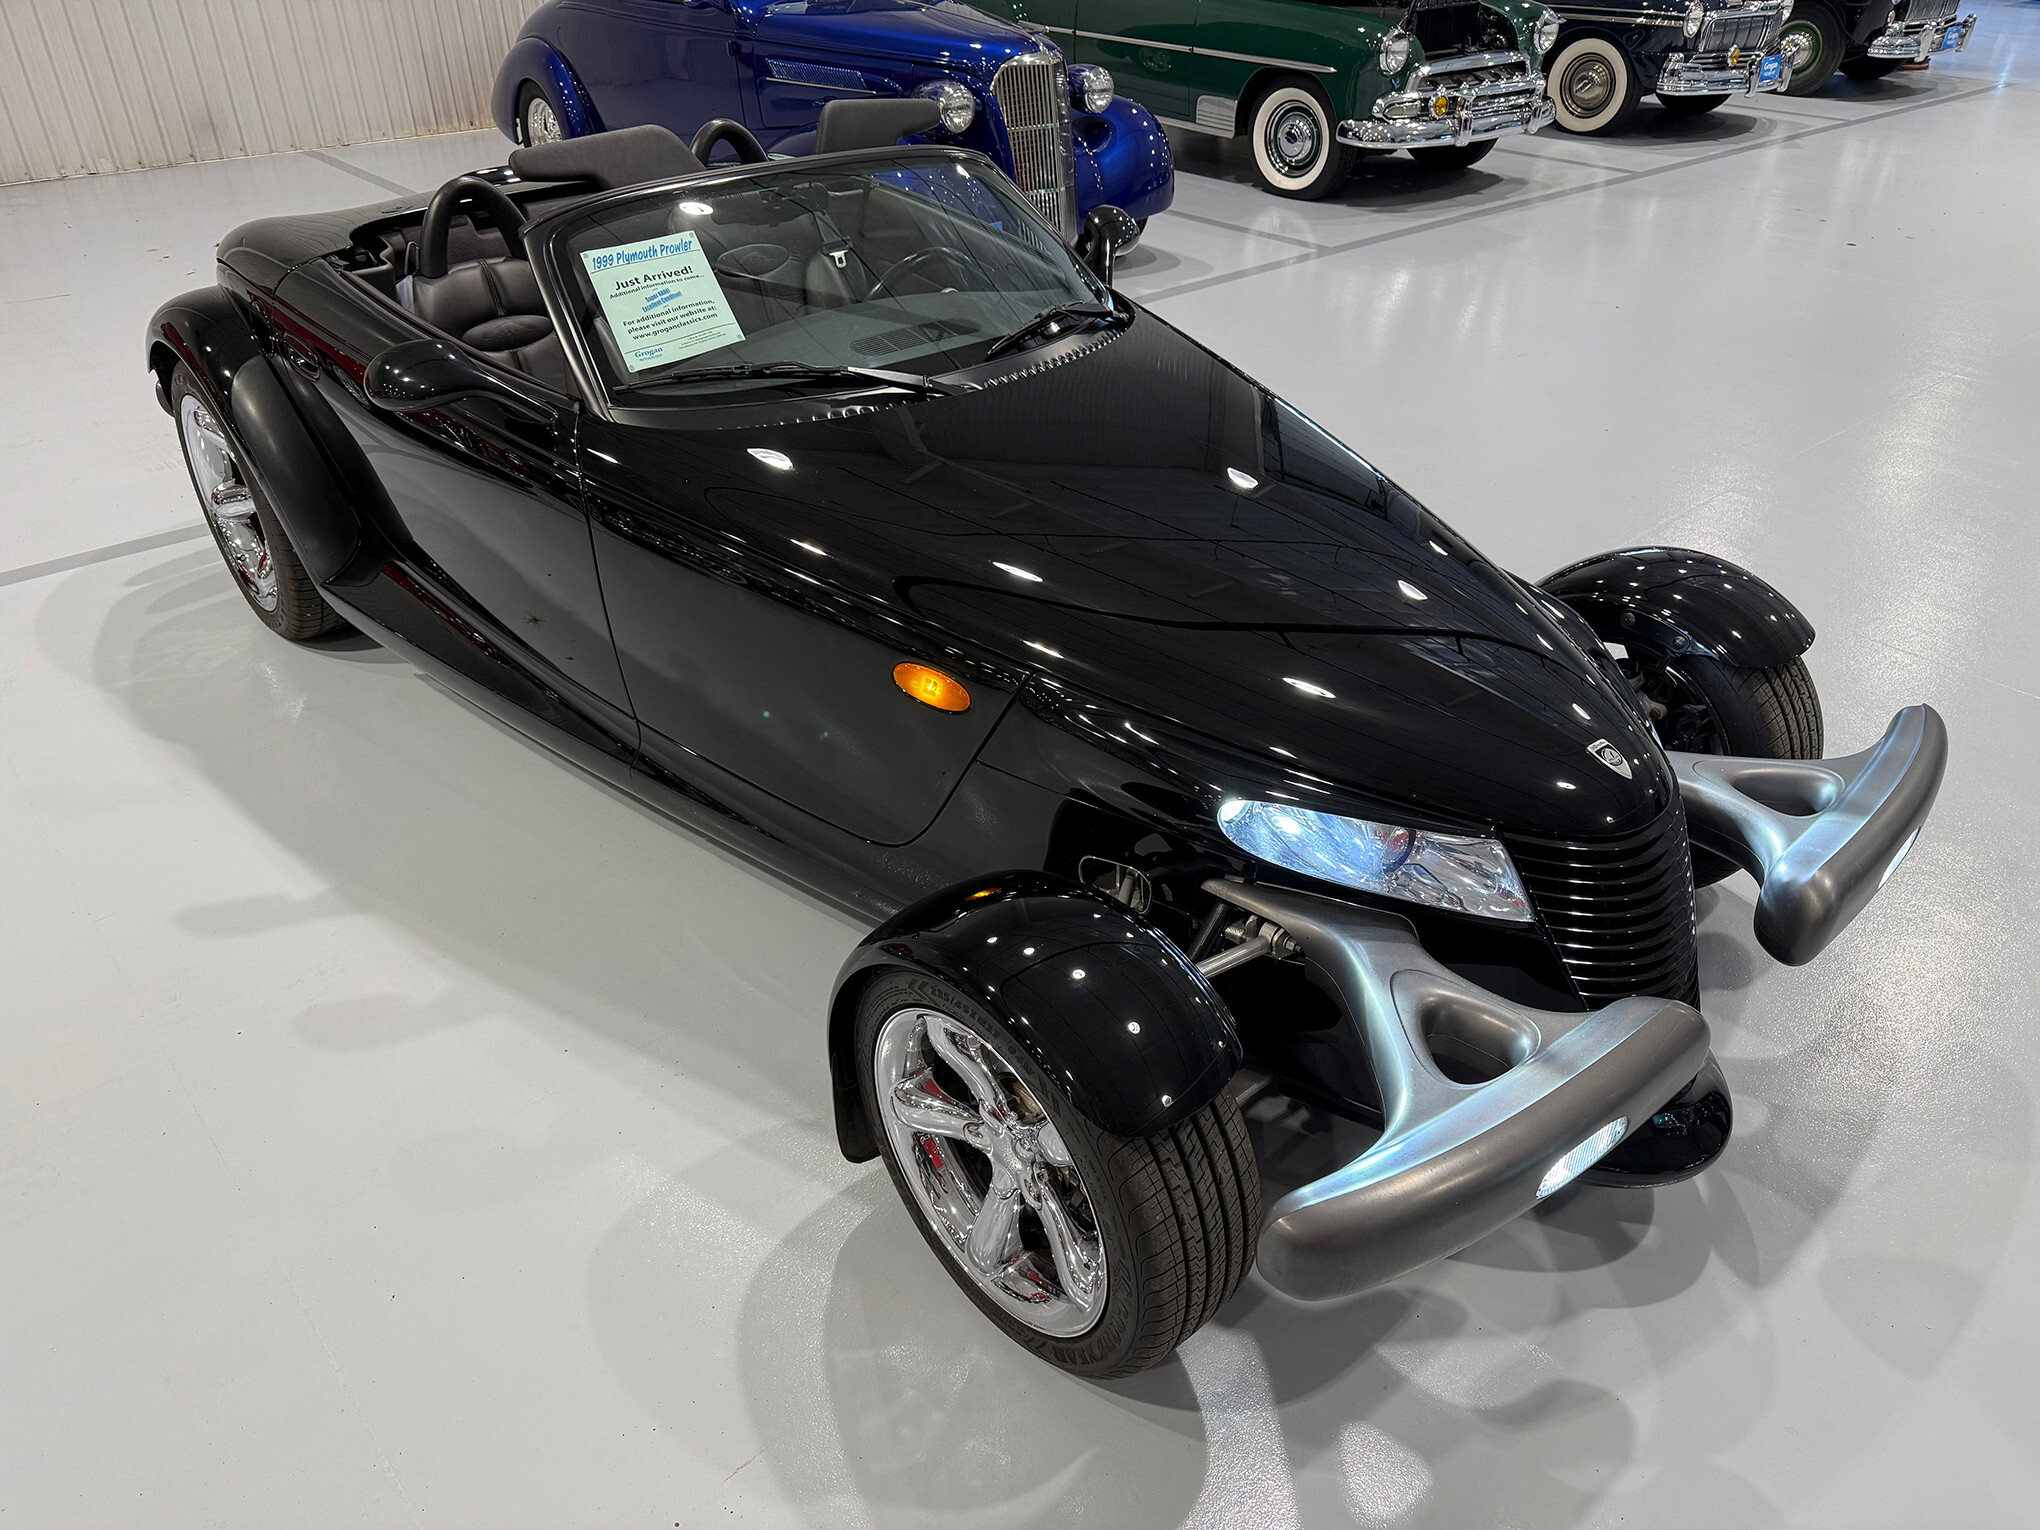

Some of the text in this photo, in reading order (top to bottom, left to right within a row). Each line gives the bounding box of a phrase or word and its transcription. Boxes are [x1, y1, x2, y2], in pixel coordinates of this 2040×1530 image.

[592, 239, 693, 271] 1999 Plymouth Prowler
[609, 286, 641, 300] Additional
[641, 279, 676, 290] information
[615, 265, 693, 291] Just Arrived!
[622, 298, 715, 327] For additional information,
[627, 324, 651, 335] please
[651, 318, 667, 328] visit
[680, 307, 707, 319] website
[632, 312, 719, 341] www.groganclassics.com
[634, 347, 664, 358] Grogan
